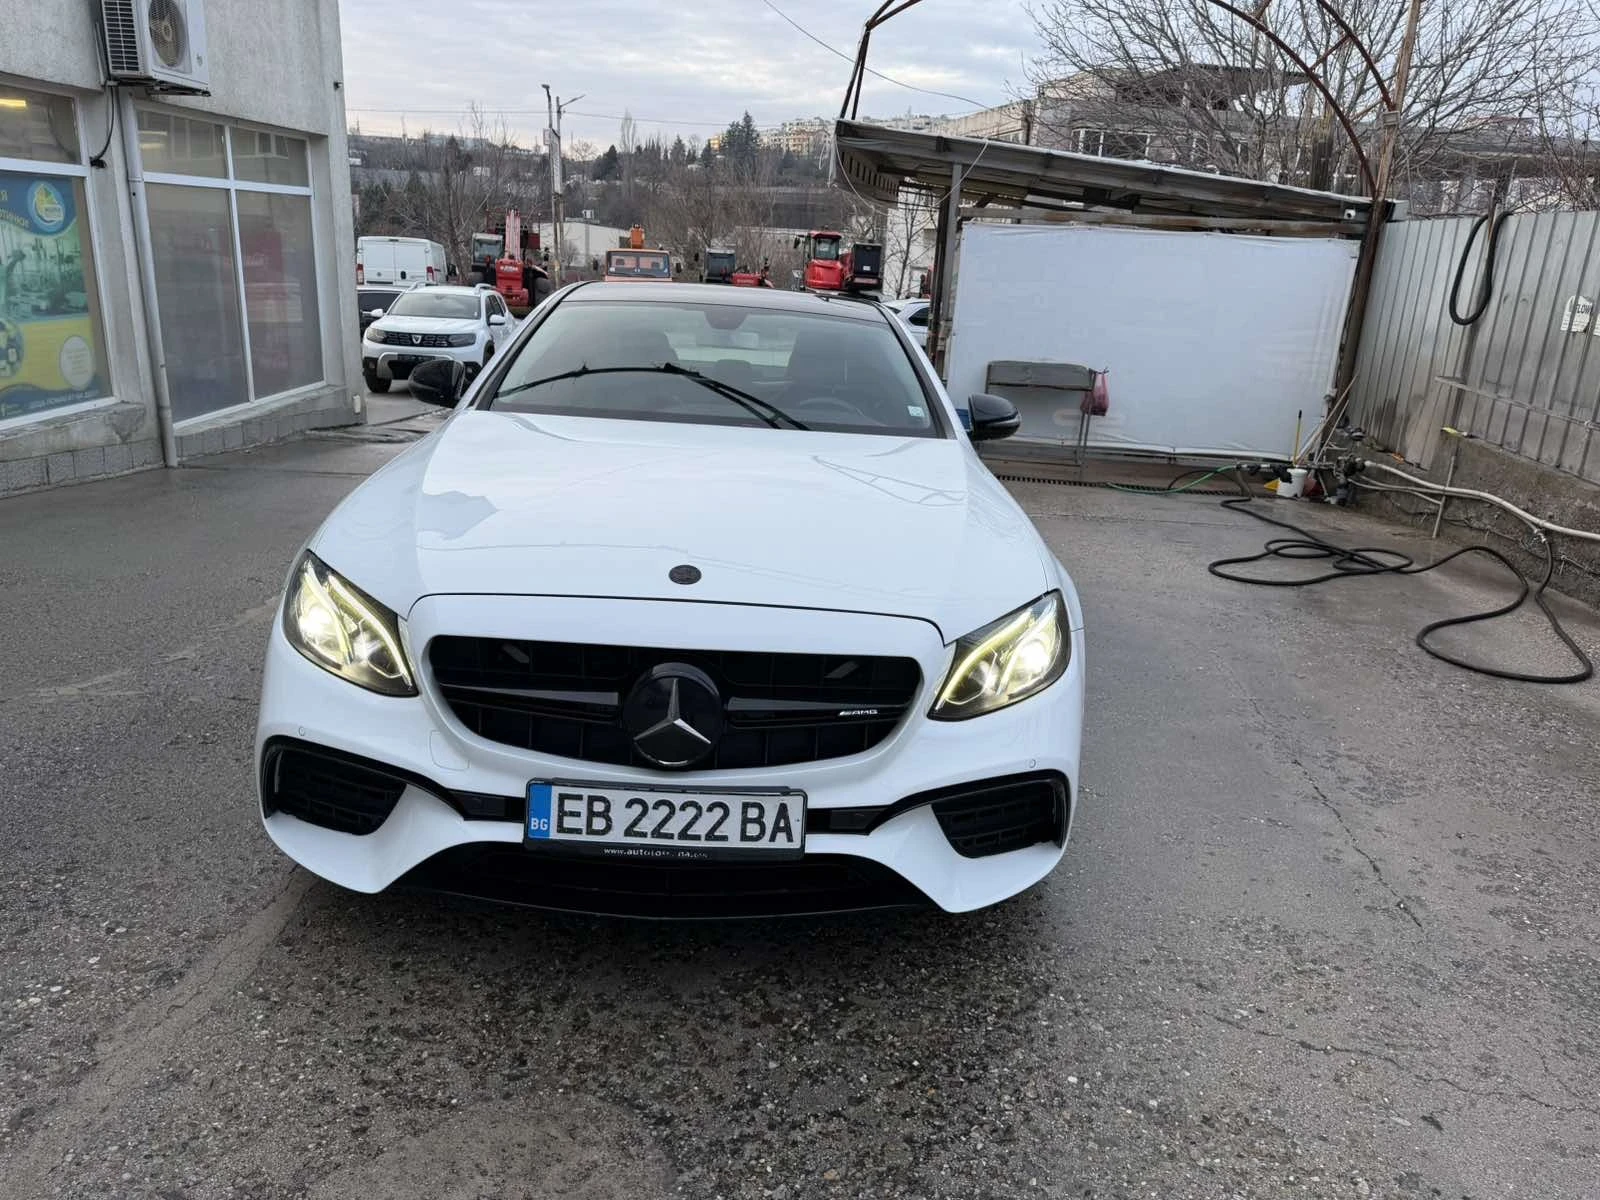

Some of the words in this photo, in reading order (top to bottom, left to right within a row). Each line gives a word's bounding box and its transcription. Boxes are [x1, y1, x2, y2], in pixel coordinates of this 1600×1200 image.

[531, 818, 548, 831] BG
[556, 792, 613, 836] EB
[623, 797, 730, 841] 2222
[739, 801, 794, 843] BA
